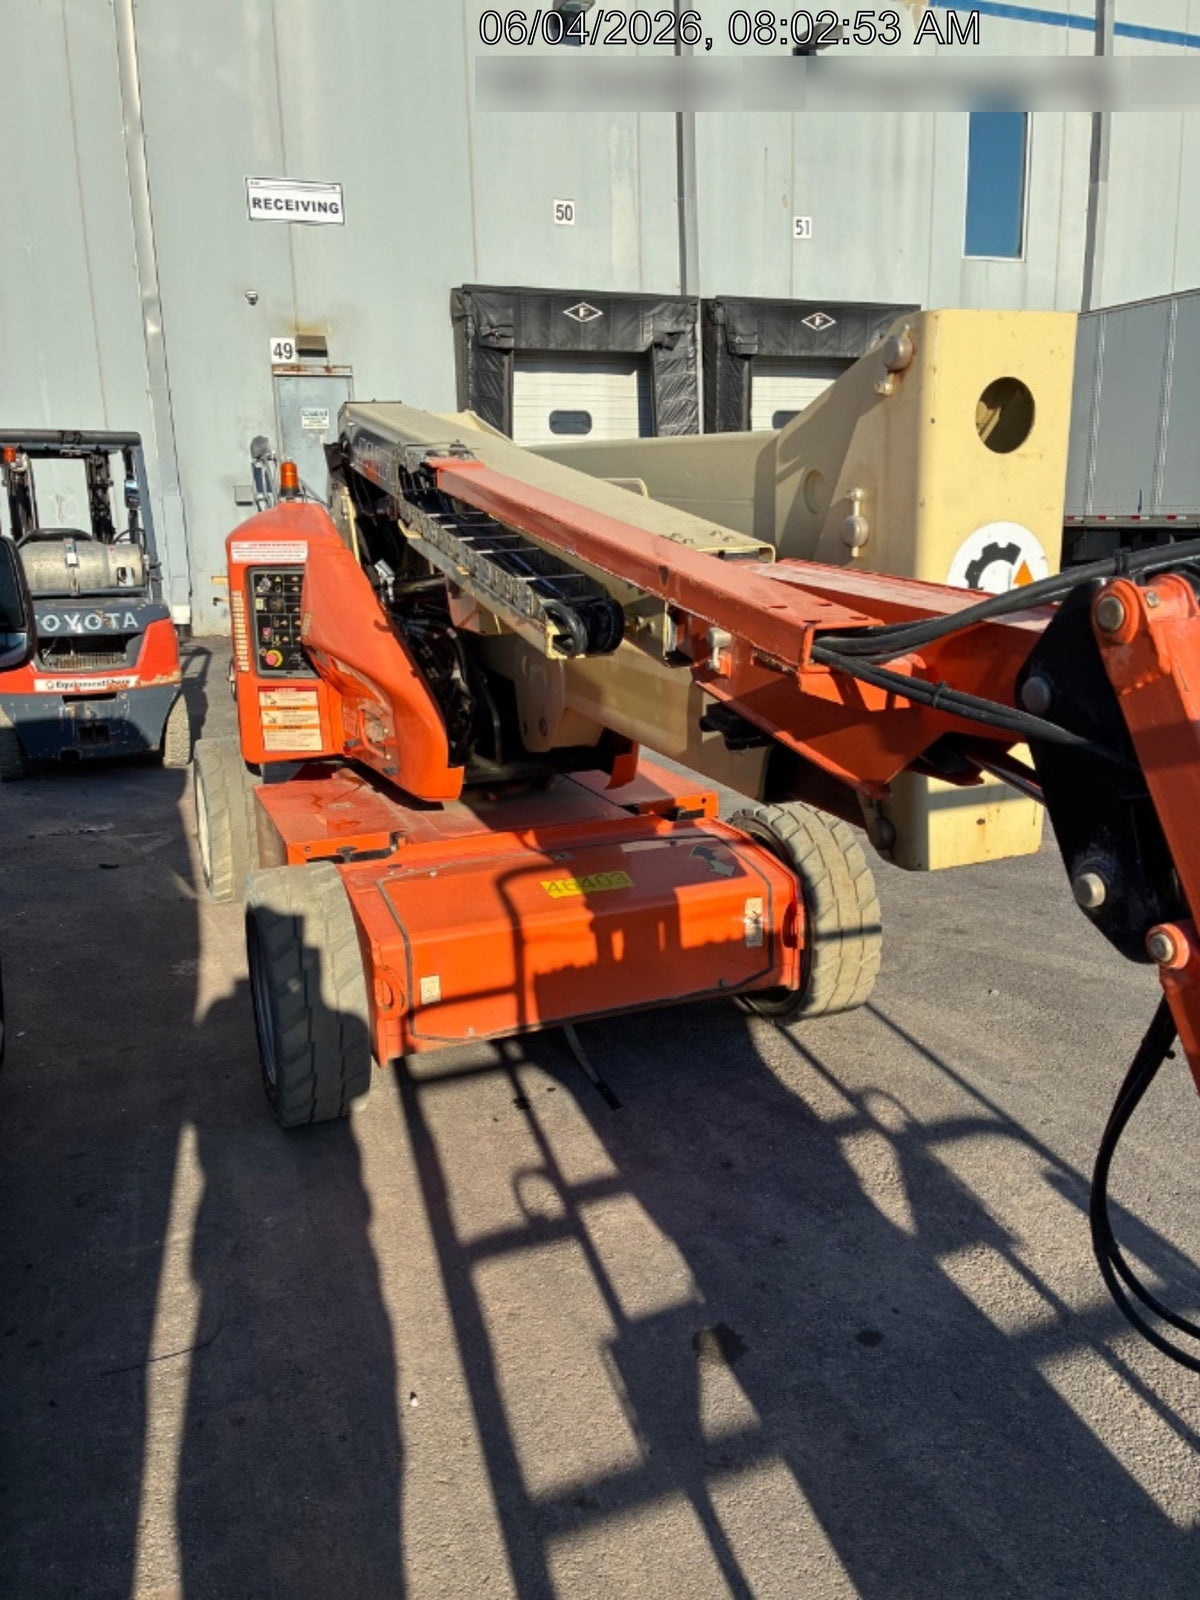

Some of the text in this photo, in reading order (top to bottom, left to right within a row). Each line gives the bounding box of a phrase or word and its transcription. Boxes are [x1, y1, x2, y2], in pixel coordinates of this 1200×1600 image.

[251, 197, 340, 214] RECEIVING
[555, 204, 573, 221] 50
[795, 219, 810, 236] 51
[273, 342, 293, 360] 49
[35, 611, 139, 633] OYOTA
[547, 872, 630, 893] 46403
